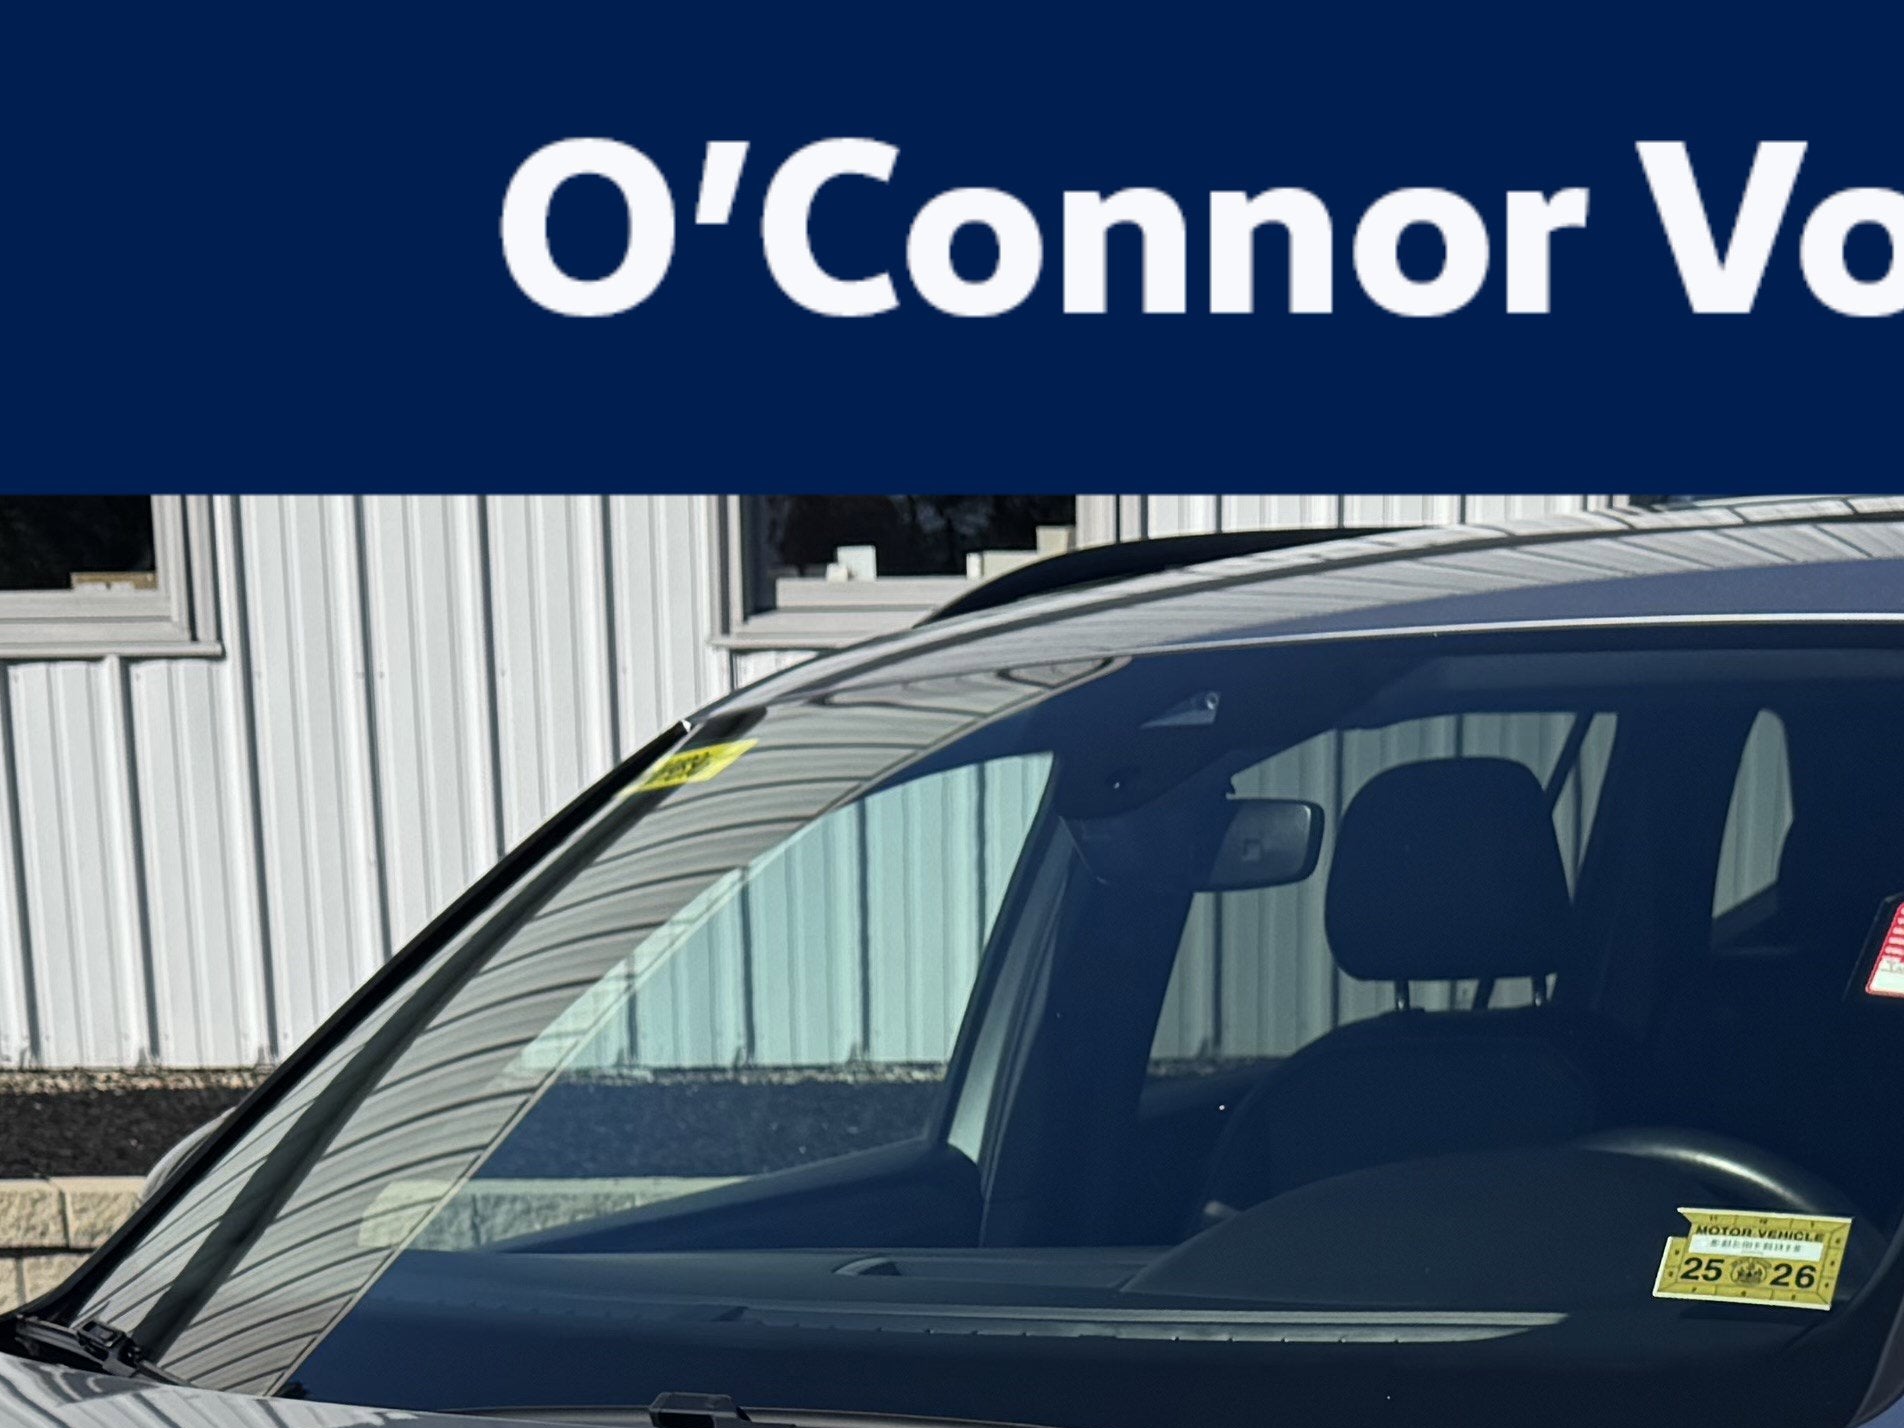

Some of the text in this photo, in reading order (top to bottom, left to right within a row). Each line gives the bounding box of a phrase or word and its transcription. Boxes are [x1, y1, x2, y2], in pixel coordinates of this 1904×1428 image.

[1694, 1224, 1826, 1243] MOTOR VEHICLE
[1679, 1256, 1726, 1283] 25
[1768, 1262, 1818, 1290] 26
